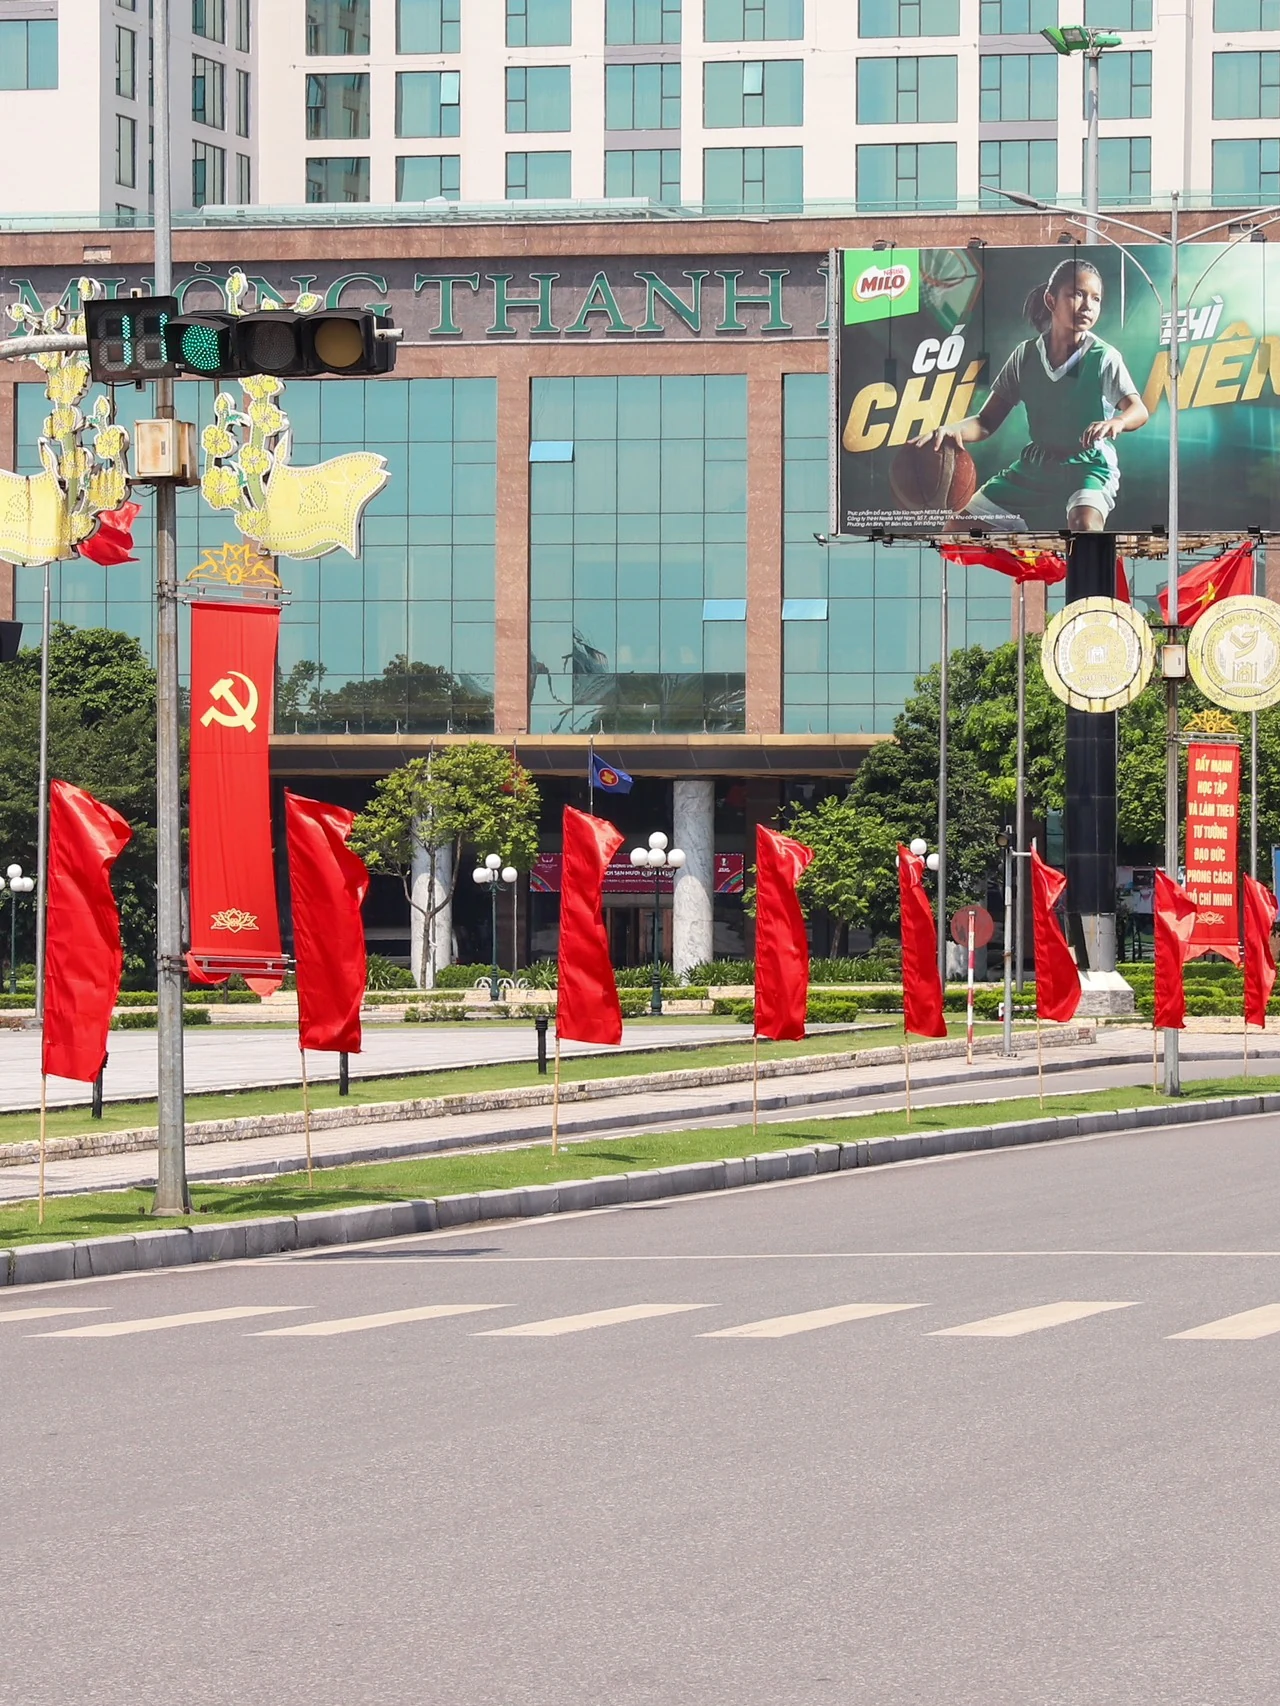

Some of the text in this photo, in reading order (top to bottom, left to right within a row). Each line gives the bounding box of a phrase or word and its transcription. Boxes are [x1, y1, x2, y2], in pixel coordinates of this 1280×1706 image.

[860, 274, 906, 293] MILO
[414, 269, 793, 335] THANH
[911, 323, 966, 375] CÓ
[841, 359, 987, 453] CHÍ
[1197, 780, 1212, 797] HỌC
[1188, 800, 1198, 816] VÀ
[1216, 803, 1235, 818] THEO
[1186, 868, 1233, 885] PHONG CÁCH
[1198, 889, 1212, 906] CHÍ
[1212, 893, 1233, 907] MINH
